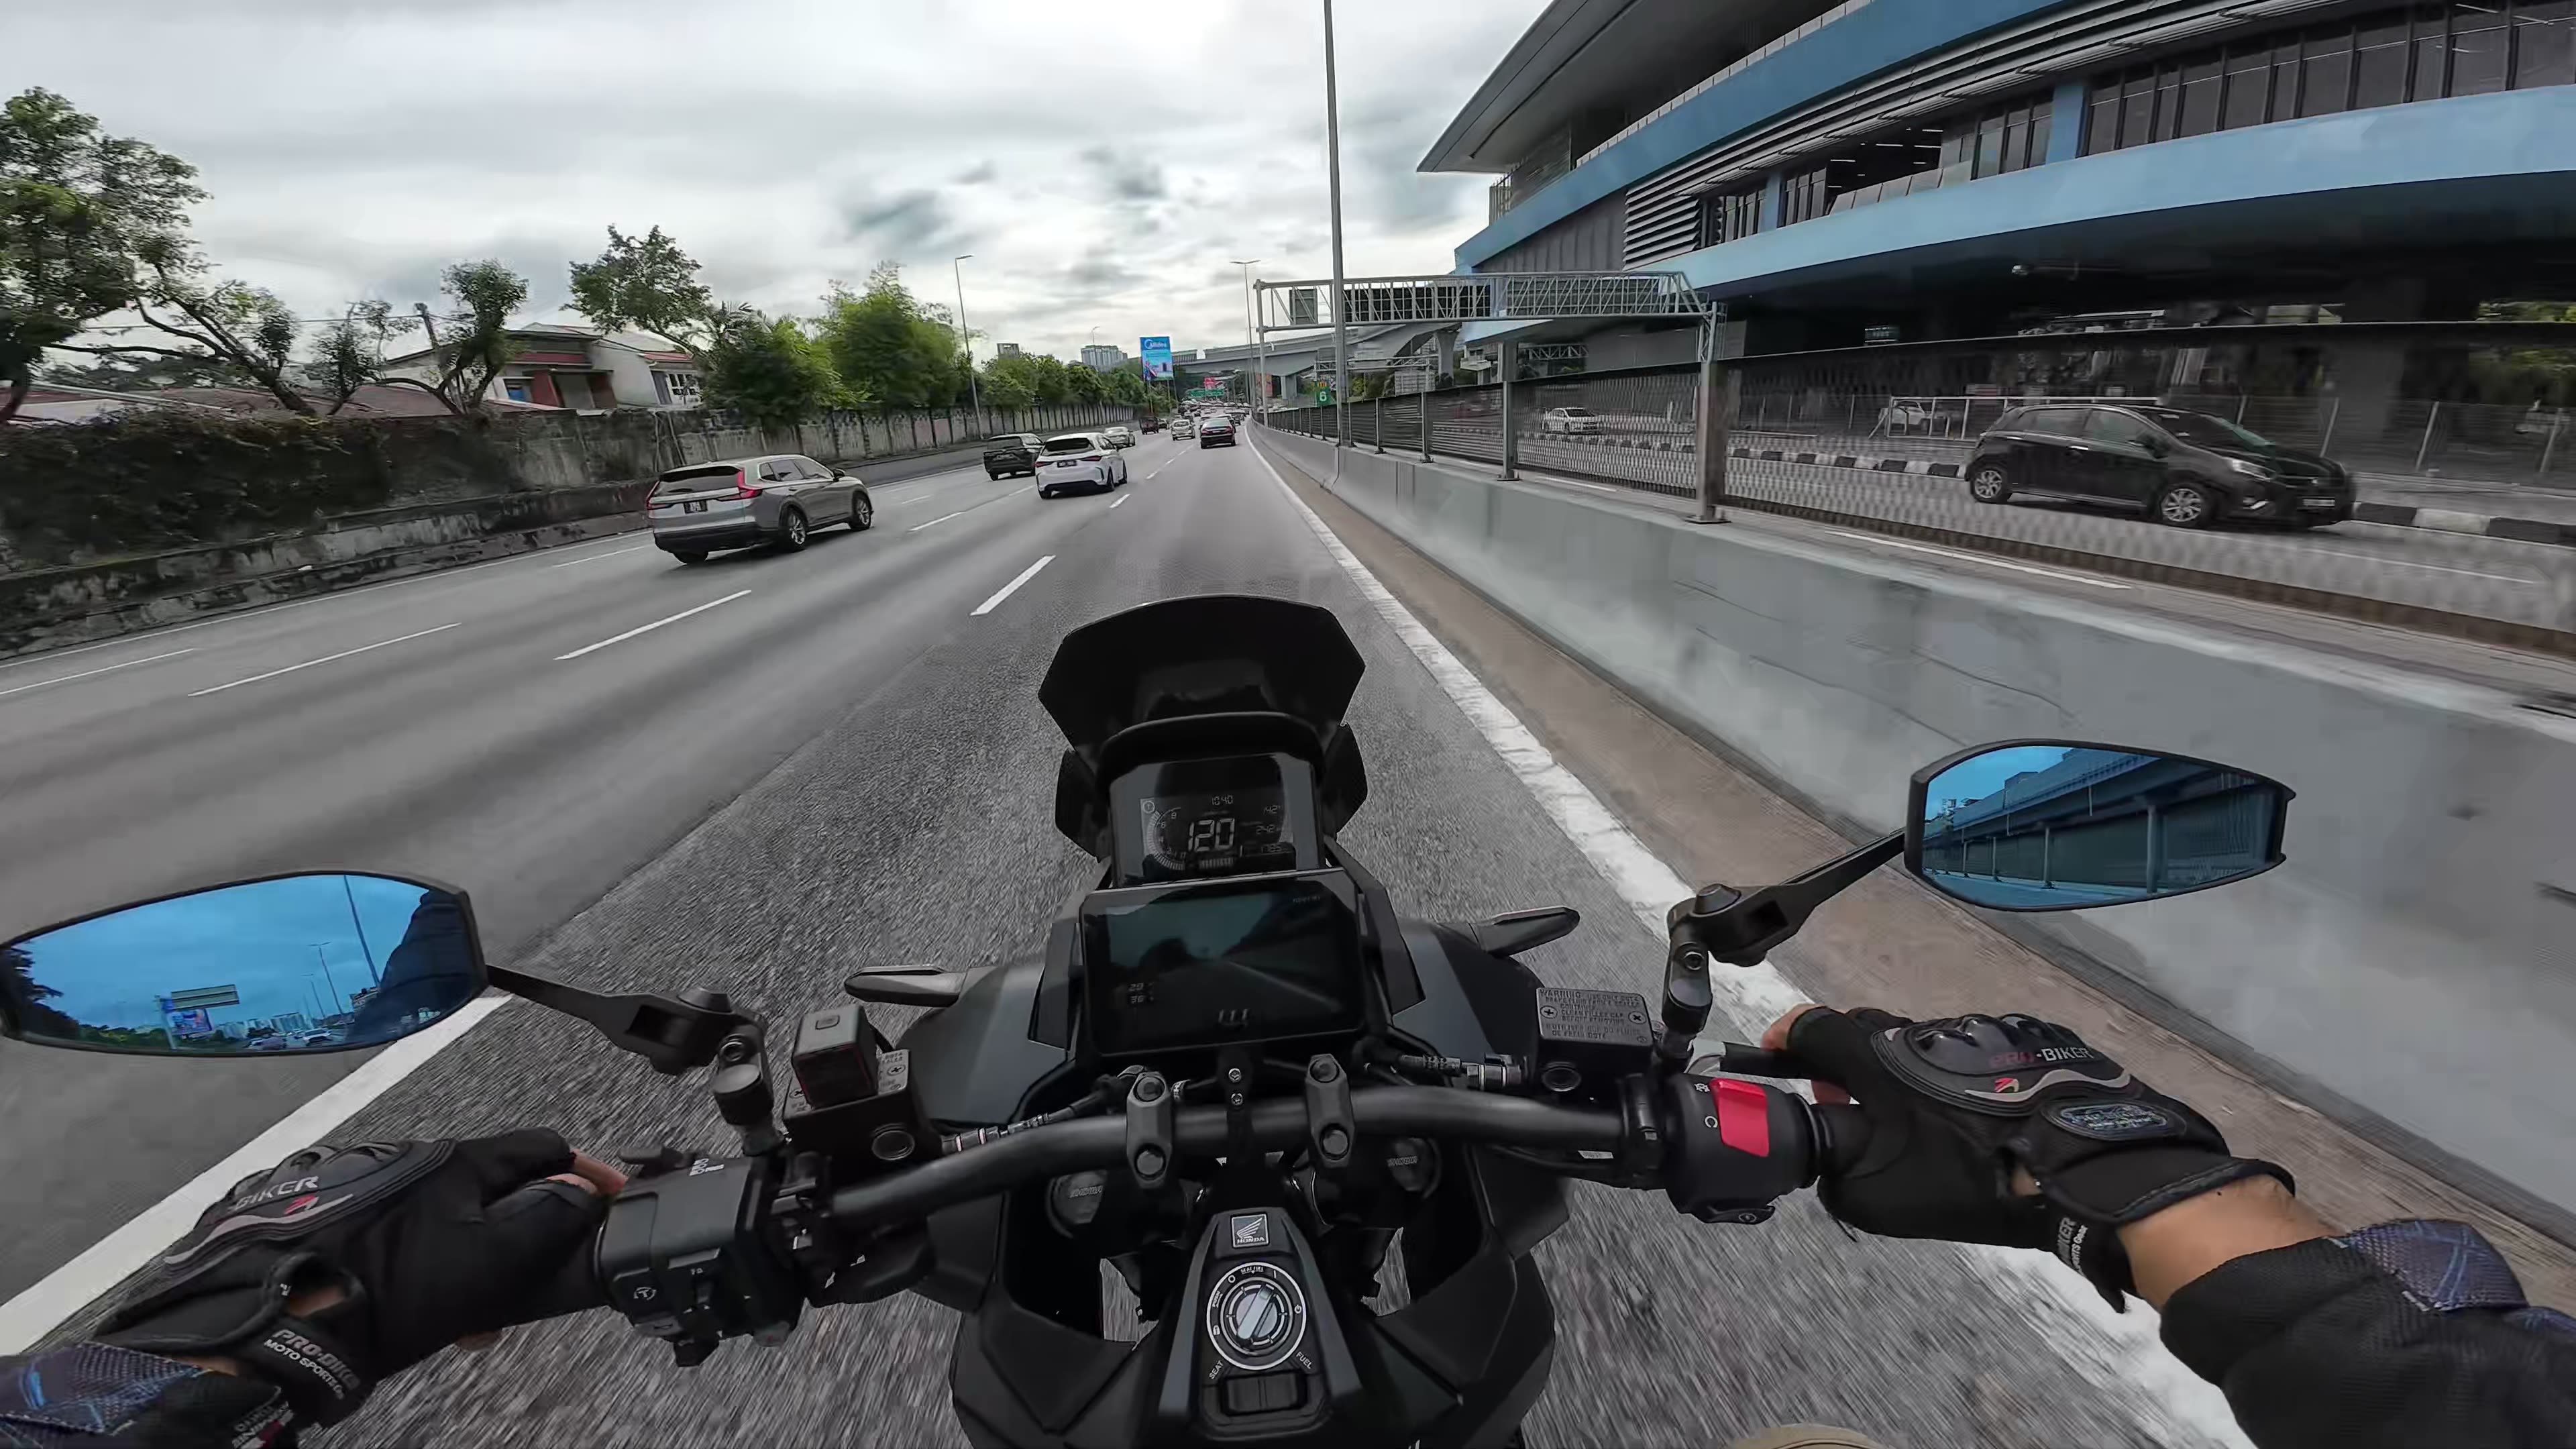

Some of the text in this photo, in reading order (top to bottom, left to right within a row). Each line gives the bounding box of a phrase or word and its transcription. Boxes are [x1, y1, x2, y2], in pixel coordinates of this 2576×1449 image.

[1320, 391, 1327, 401] 6
[1187, 817, 1236, 852] 120
[264, 1338, 301, 1360] MOTO
[1209, 1360, 1224, 1381] SEAT
[1295, 1351, 1313, 1369] FUEL
